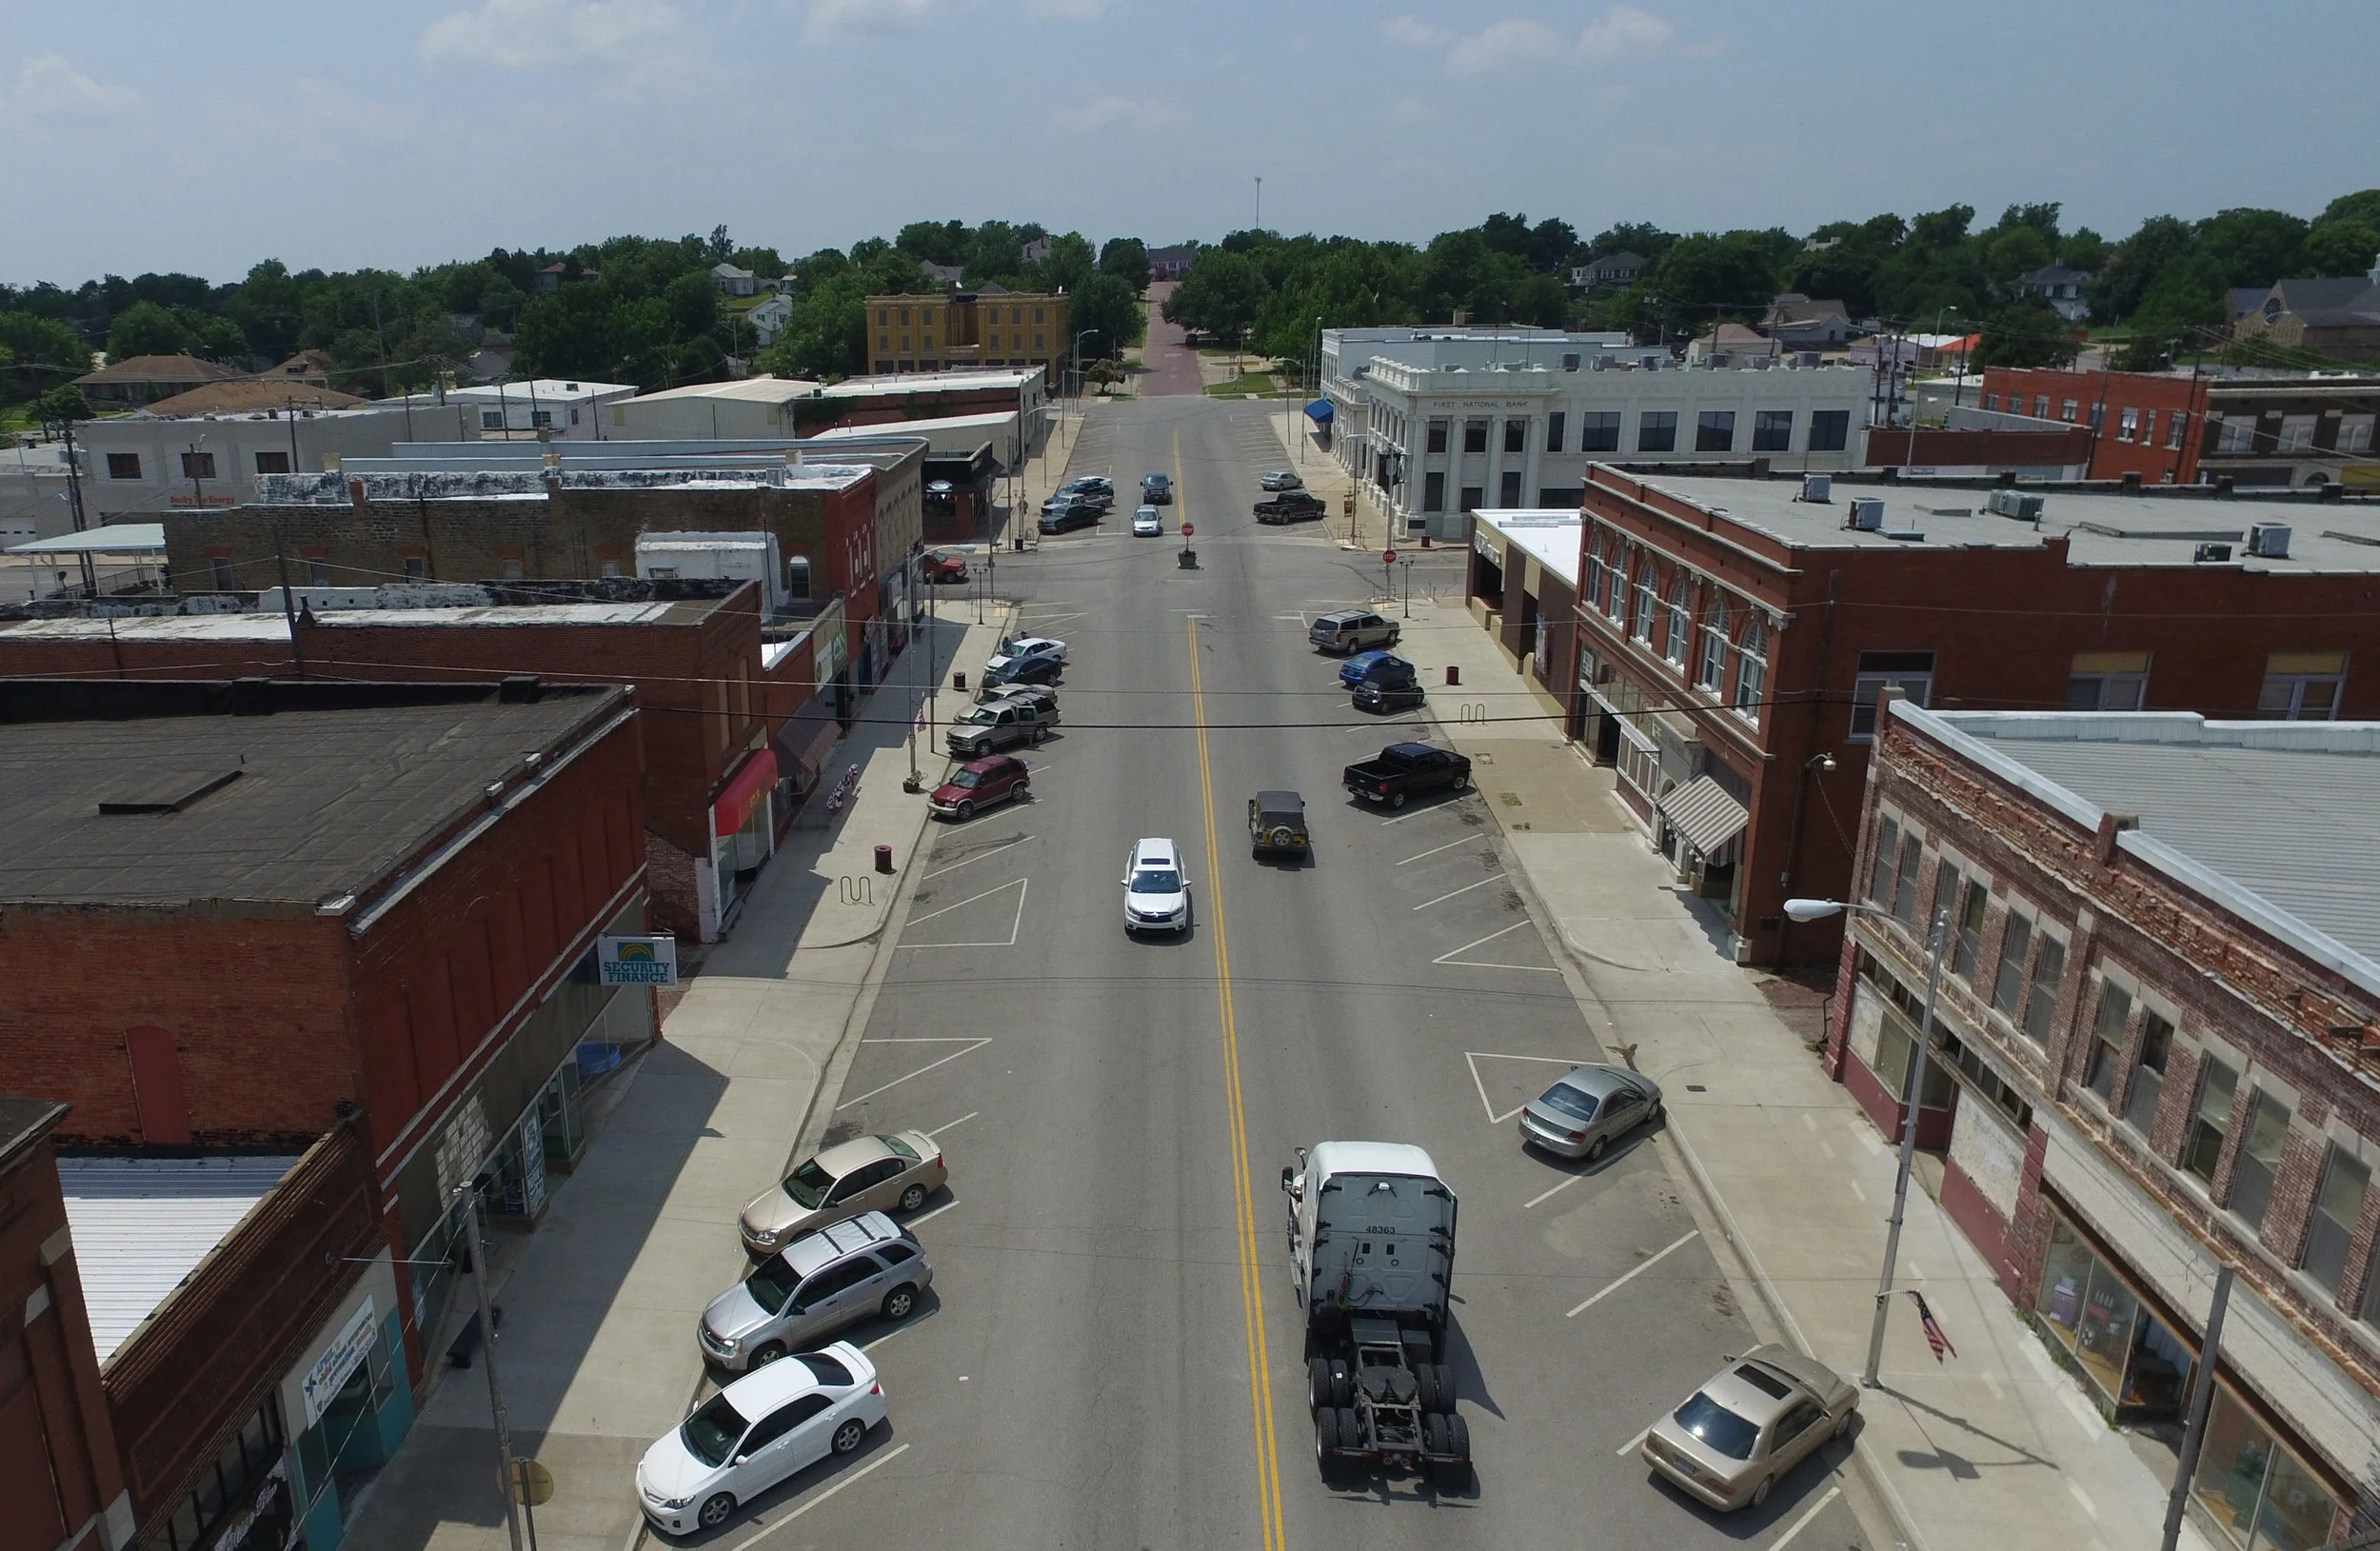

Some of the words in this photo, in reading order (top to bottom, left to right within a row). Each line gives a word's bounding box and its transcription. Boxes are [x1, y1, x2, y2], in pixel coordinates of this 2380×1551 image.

[208, 496, 235, 505] Energy
[604, 962, 670, 972] SECURITY
[608, 971, 668, 984] FINANCE
[1365, 1225, 1396, 1235] 48363
